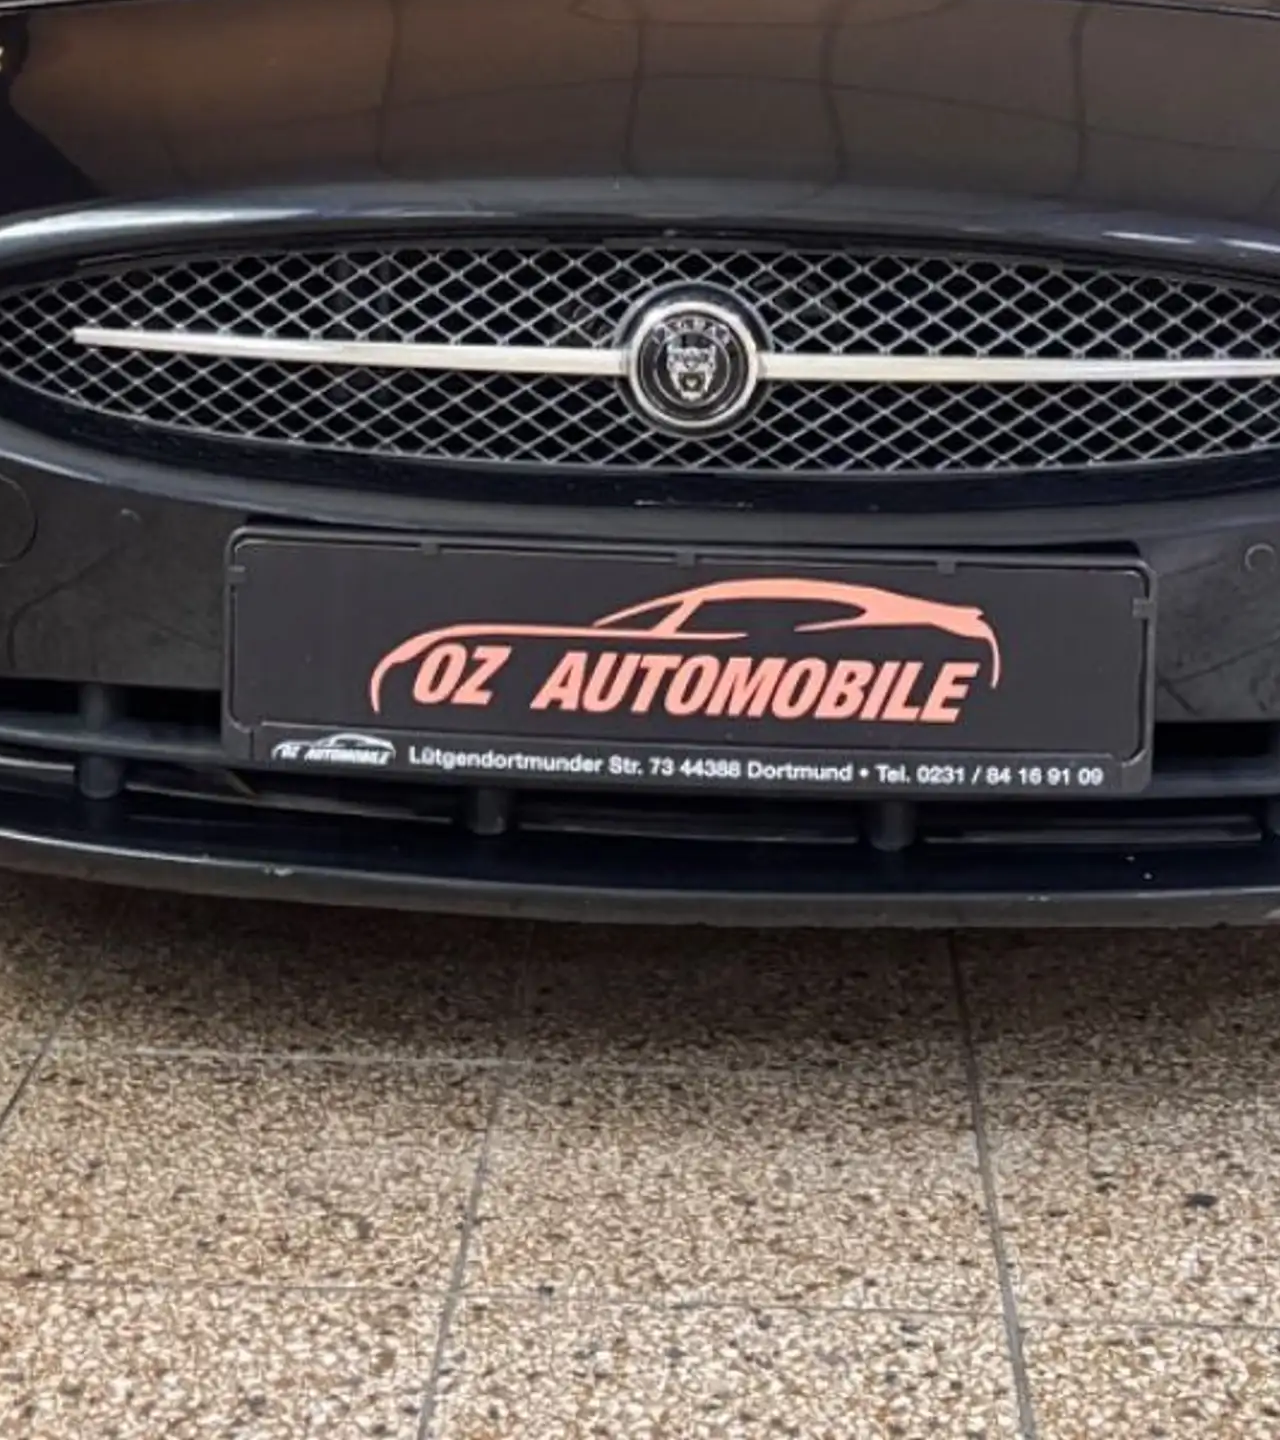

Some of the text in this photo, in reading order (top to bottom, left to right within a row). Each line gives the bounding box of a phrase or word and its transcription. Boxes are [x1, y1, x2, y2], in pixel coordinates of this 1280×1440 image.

[413, 643, 980, 724] OZ AUTOMOBILE
[408, 746, 603, 772] Lütgendortmunder
[609, 755, 643, 775] Str.
[649, 756, 672, 776] 73
[680, 758, 741, 778] 44388
[747, 761, 853, 781] Dortmund
[874, 765, 911, 783] Tel.
[916, 765, 965, 784] 0231
[986, 766, 1011, 785] 84
[1018, 766, 1042, 786] 16
[1047, 767, 1070, 787] 91
[1077, 767, 1104, 787] 09
